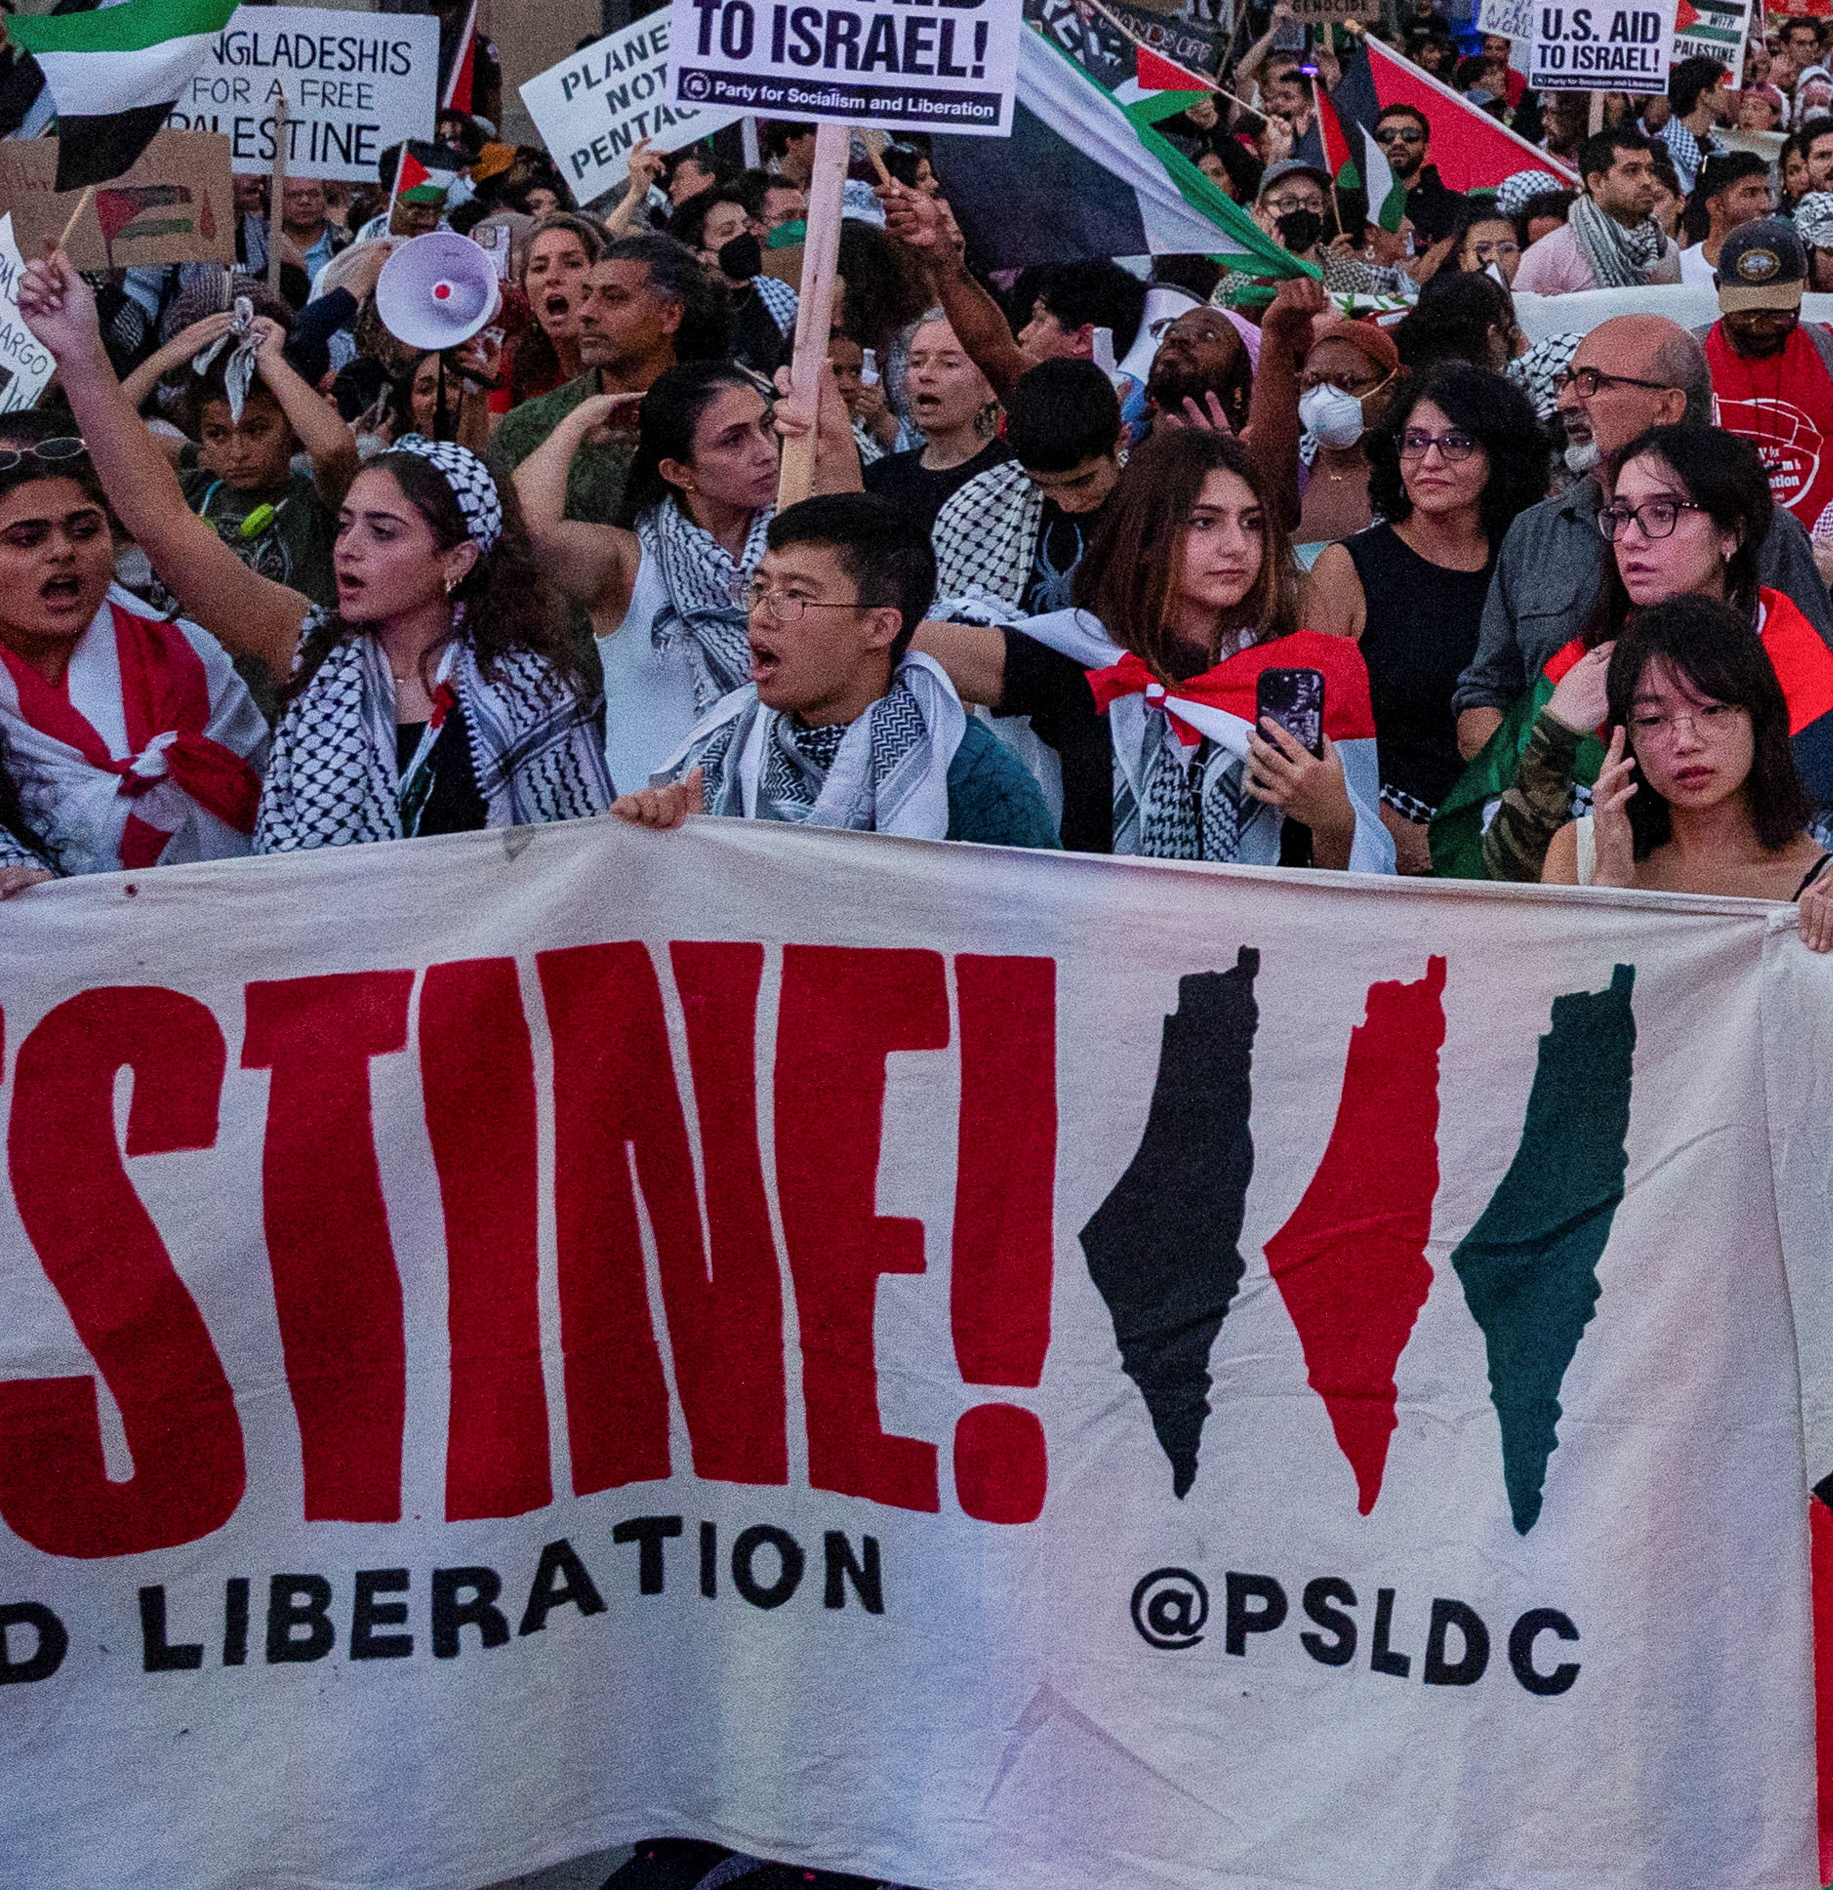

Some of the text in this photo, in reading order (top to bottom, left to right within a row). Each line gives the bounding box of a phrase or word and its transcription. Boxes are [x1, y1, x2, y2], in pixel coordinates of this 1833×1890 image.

[1542, 8, 1661, 44] U.S. AID
[1710, 13, 1736, 29] WITH
[770, 4, 990, 79] ISRAEL!
[1538, 44, 1660, 73] TO ISRAEL!
[193, 76, 374, 110] FOR A FREE
[715, 80, 758, 102] Party
[760, 86, 784, 102] for
[788, 88, 865, 110] Socialism
[870, 97, 902, 111] and
[907, 98, 995, 118] Liberation
[141, 1515, 885, 1672] LIBERATION
[1129, 1567, 1580, 1696] @PSLDC
